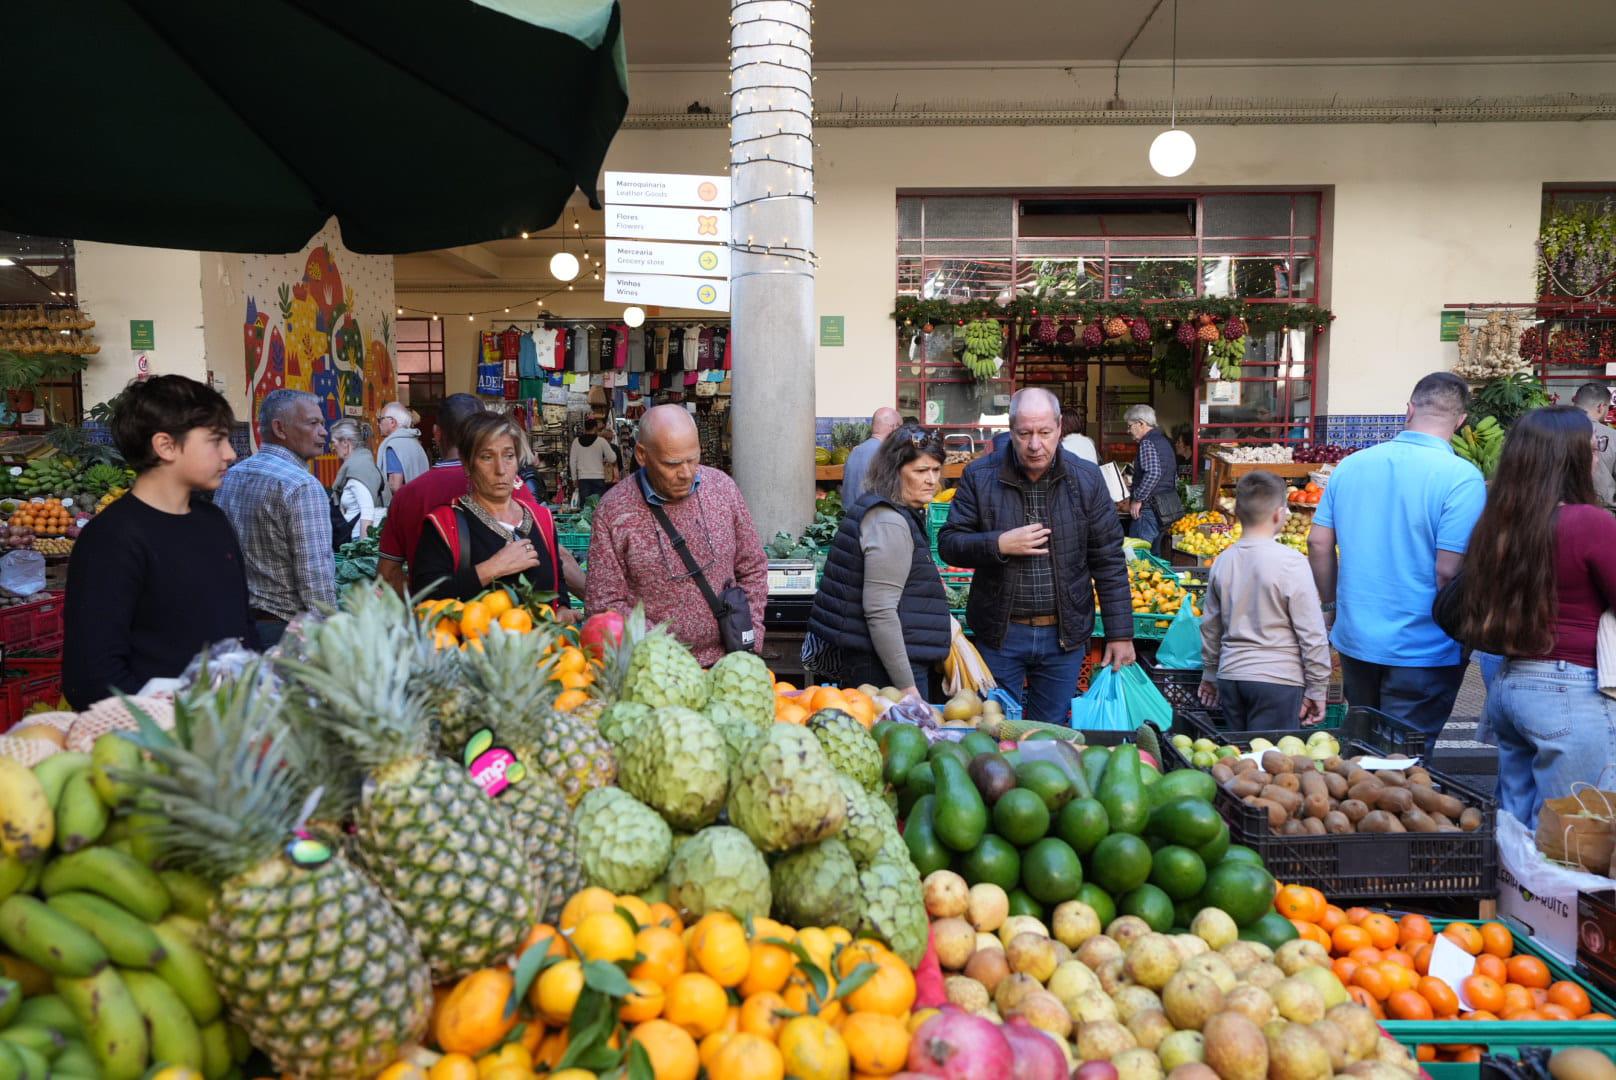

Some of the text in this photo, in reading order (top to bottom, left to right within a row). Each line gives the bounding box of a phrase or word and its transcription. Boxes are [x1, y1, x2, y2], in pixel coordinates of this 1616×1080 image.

[616, 180, 666, 189] Marroquinaria
[616, 213, 638, 221] Flores
[616, 222, 644, 230] Flowers
[617, 257, 645, 266] Grocery
[616, 279, 641, 287] Vinhos
[616, 288, 639, 297] Wines
